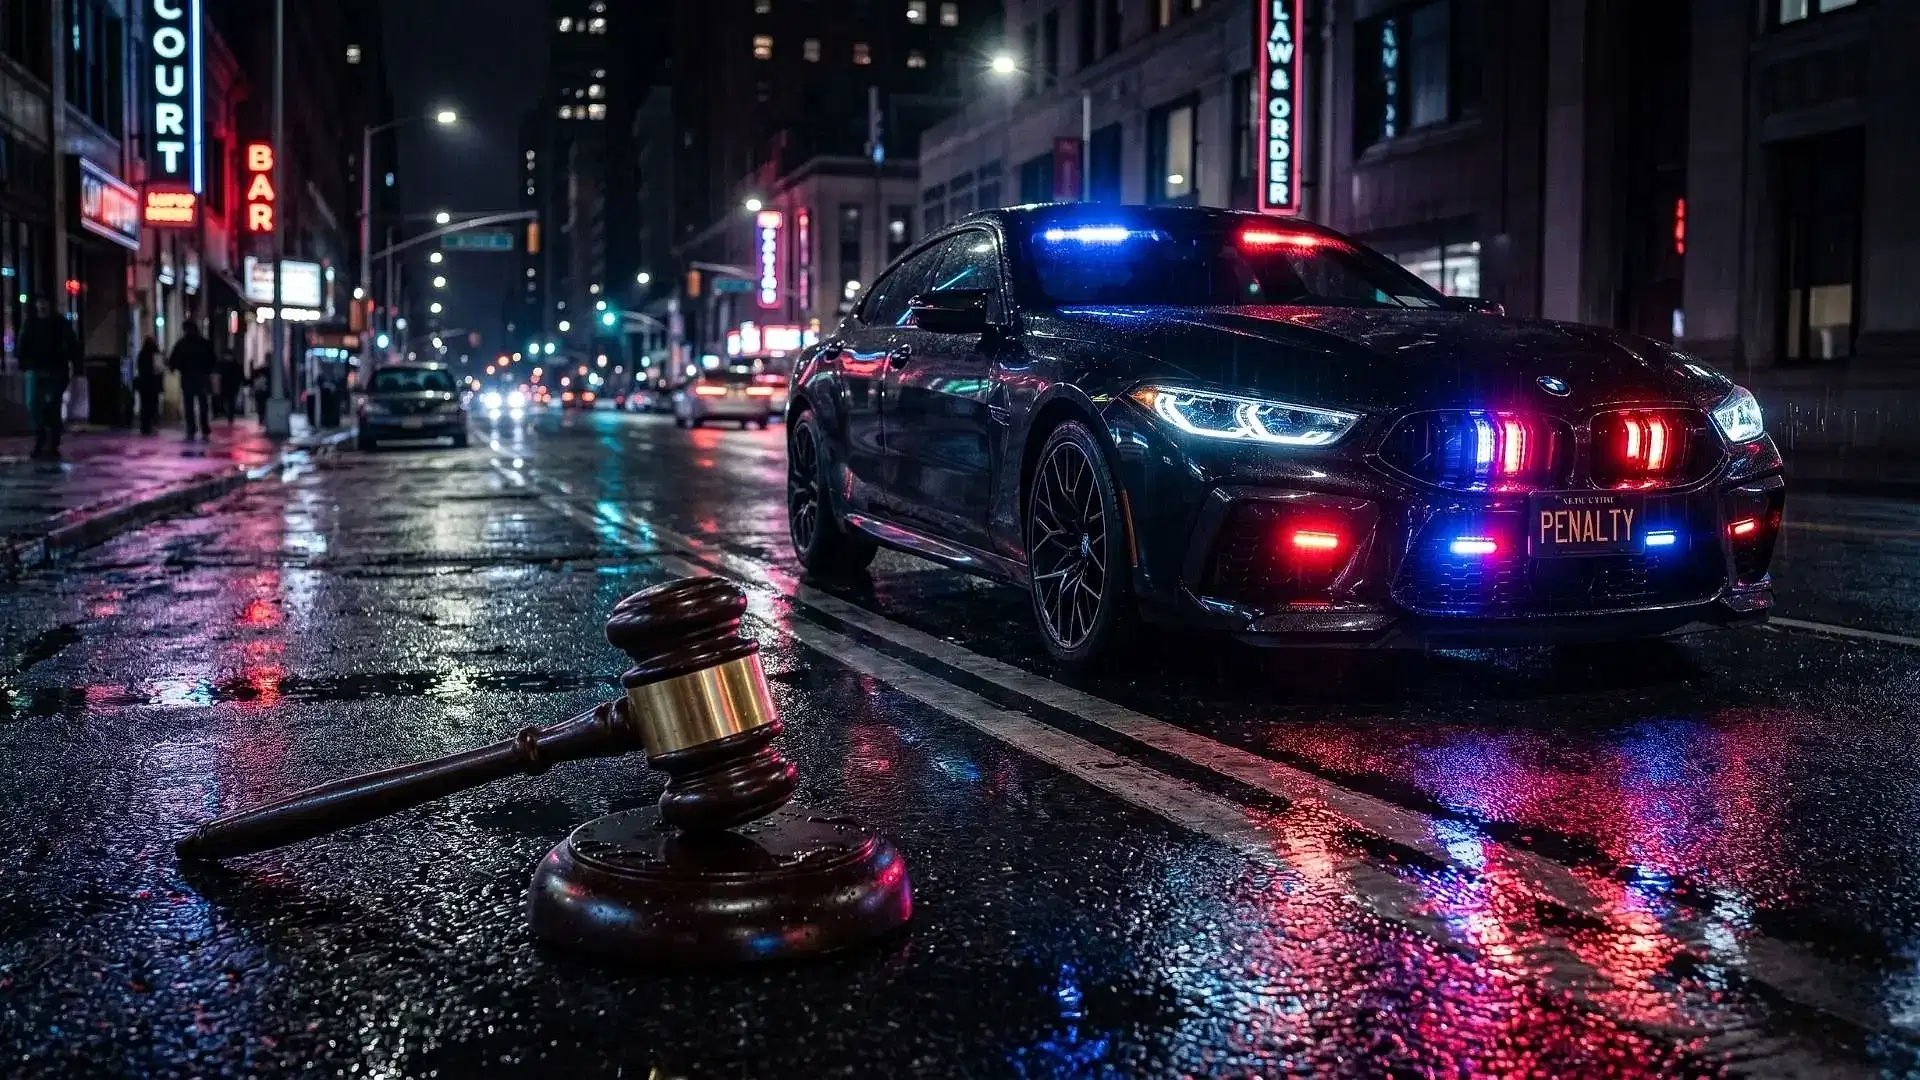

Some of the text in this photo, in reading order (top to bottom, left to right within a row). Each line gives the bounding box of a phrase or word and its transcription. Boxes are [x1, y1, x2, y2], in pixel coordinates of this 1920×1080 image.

[153, 0, 186, 173] COURT
[1267, 0, 1294, 205] LAW & ORDER
[248, 144, 274, 231] BAR
[1540, 508, 1634, 544] PENALTY
